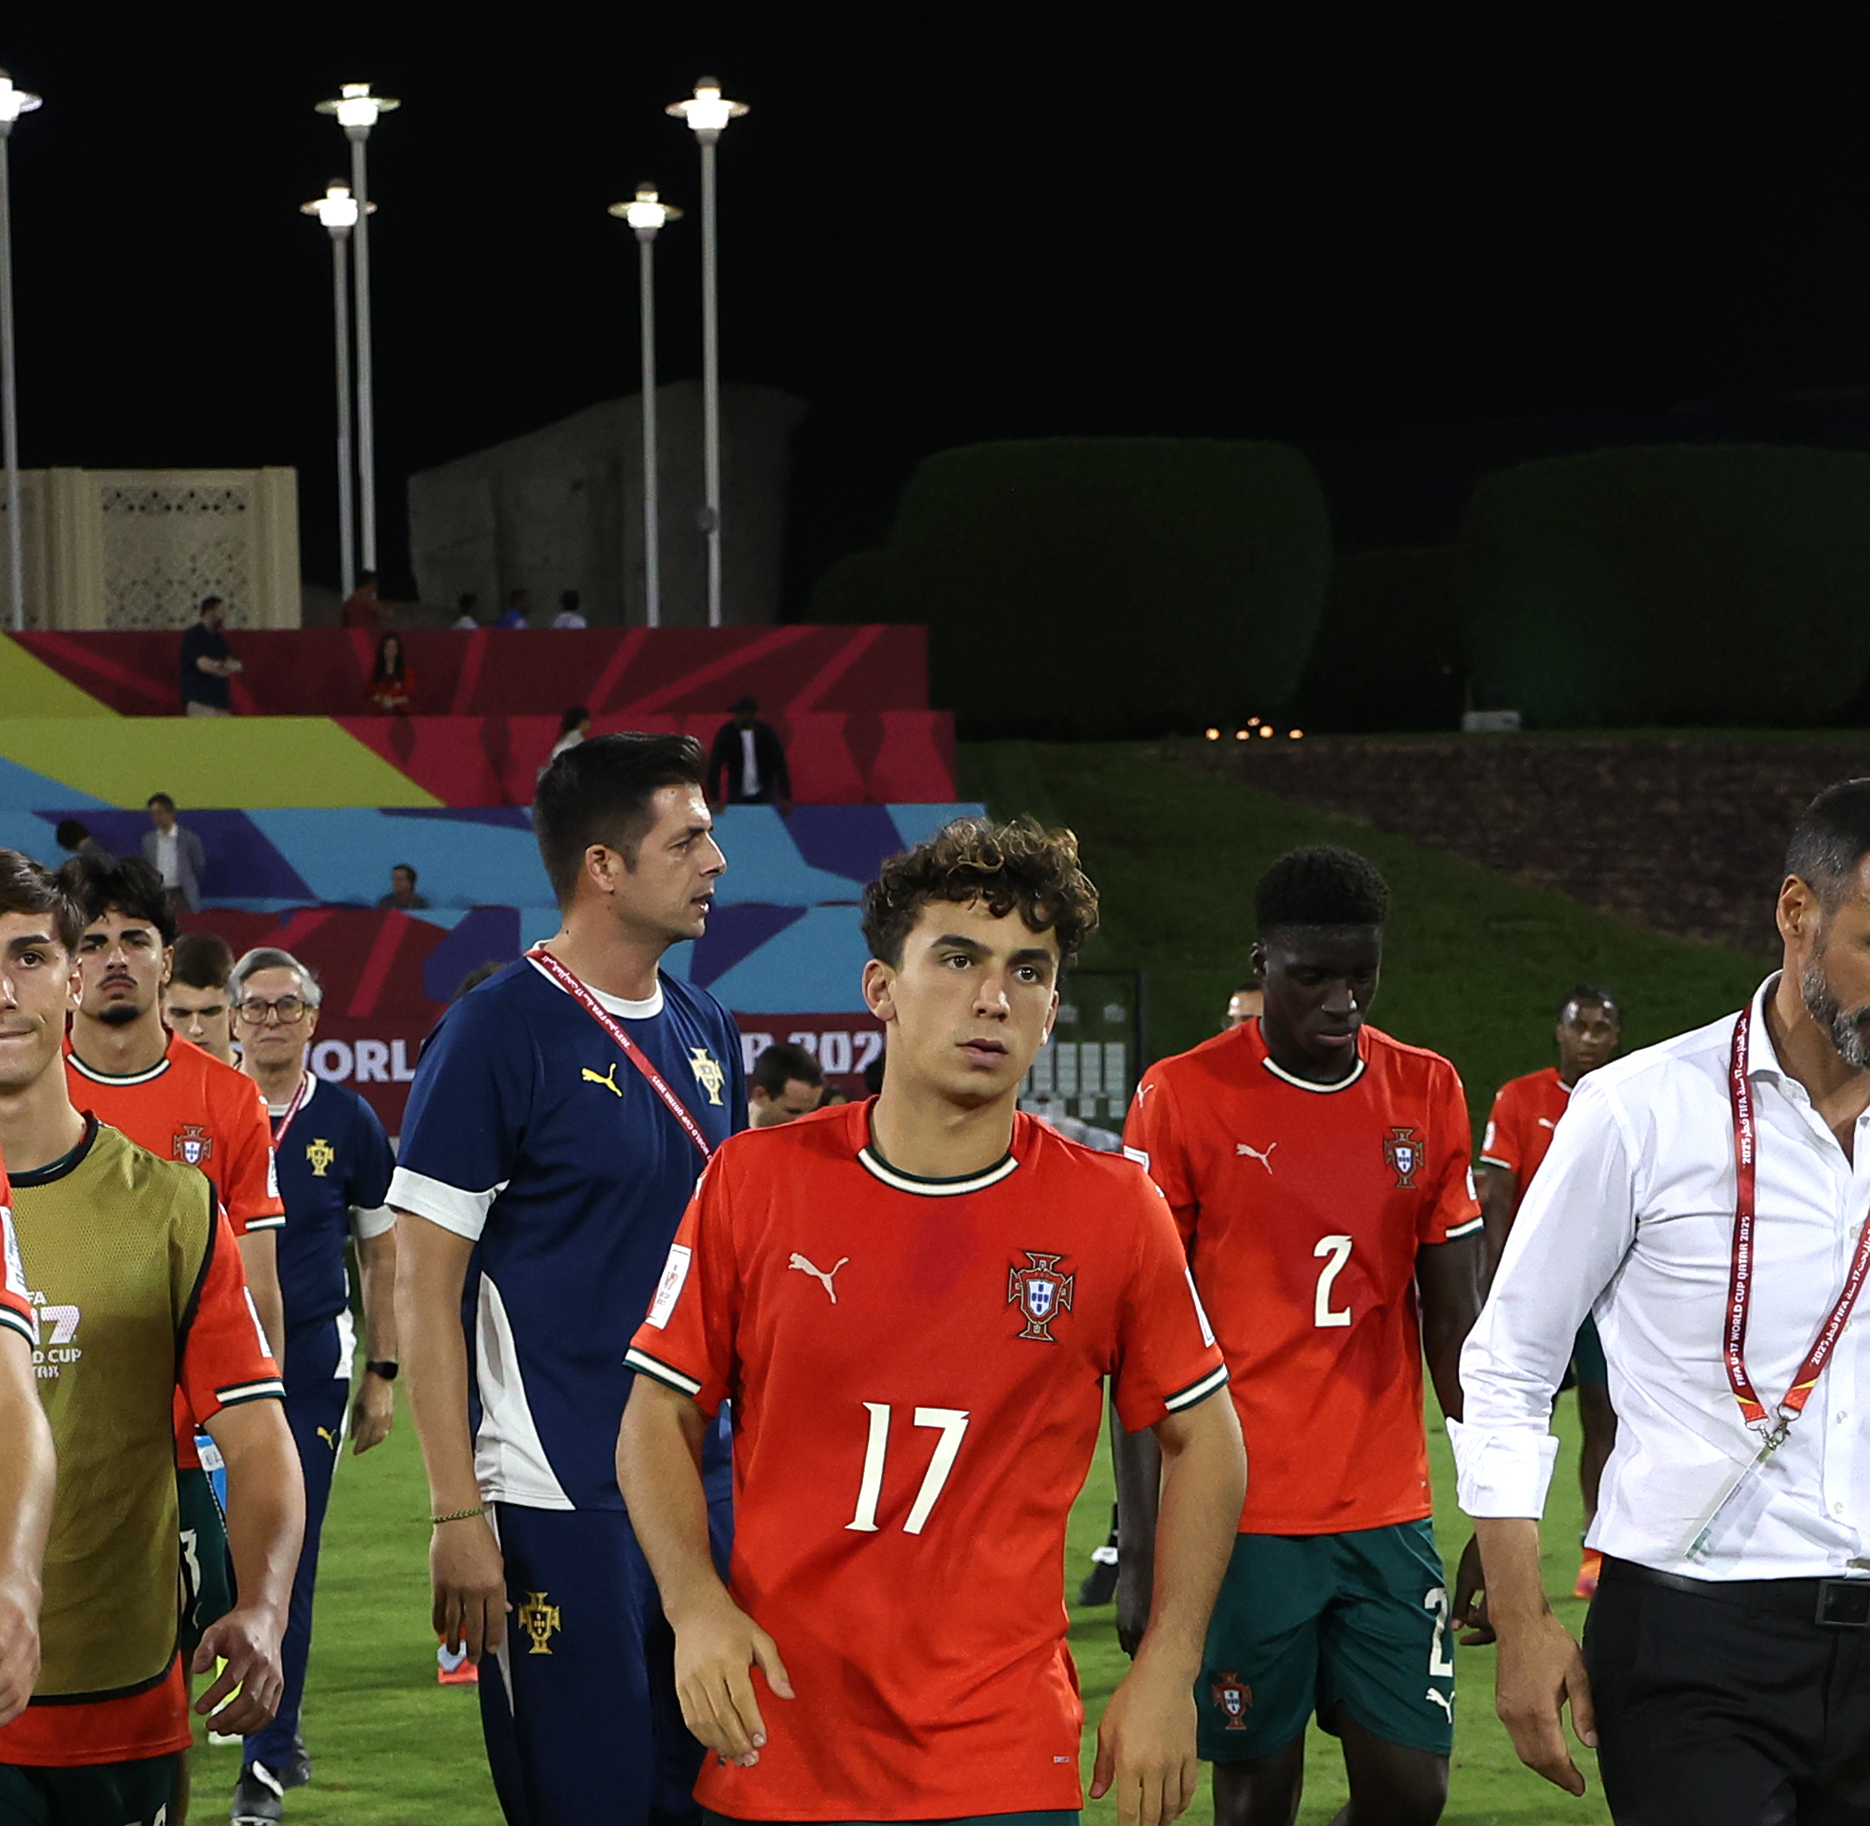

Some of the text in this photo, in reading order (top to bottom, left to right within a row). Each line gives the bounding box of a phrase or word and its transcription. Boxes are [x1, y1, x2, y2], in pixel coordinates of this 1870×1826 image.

[302, 1038, 416, 1083] ORL
[1738, 1097, 1749, 1118] FIFA
[1741, 1138, 1751, 1165] 2025
[1313, 1233, 1353, 1328] 2
[1852, 1269, 1861, 1282] 17
[1730, 1214, 1751, 1387] FIFA U-17 WORLD CUP QATAR 2025
[1833, 1300, 1850, 1323] FIFA
[48, 1348, 81, 1363] CUP
[1810, 1340, 1830, 1366] 2025
[843, 1400, 972, 1536] 17
[1423, 1587, 1455, 1678] 2
